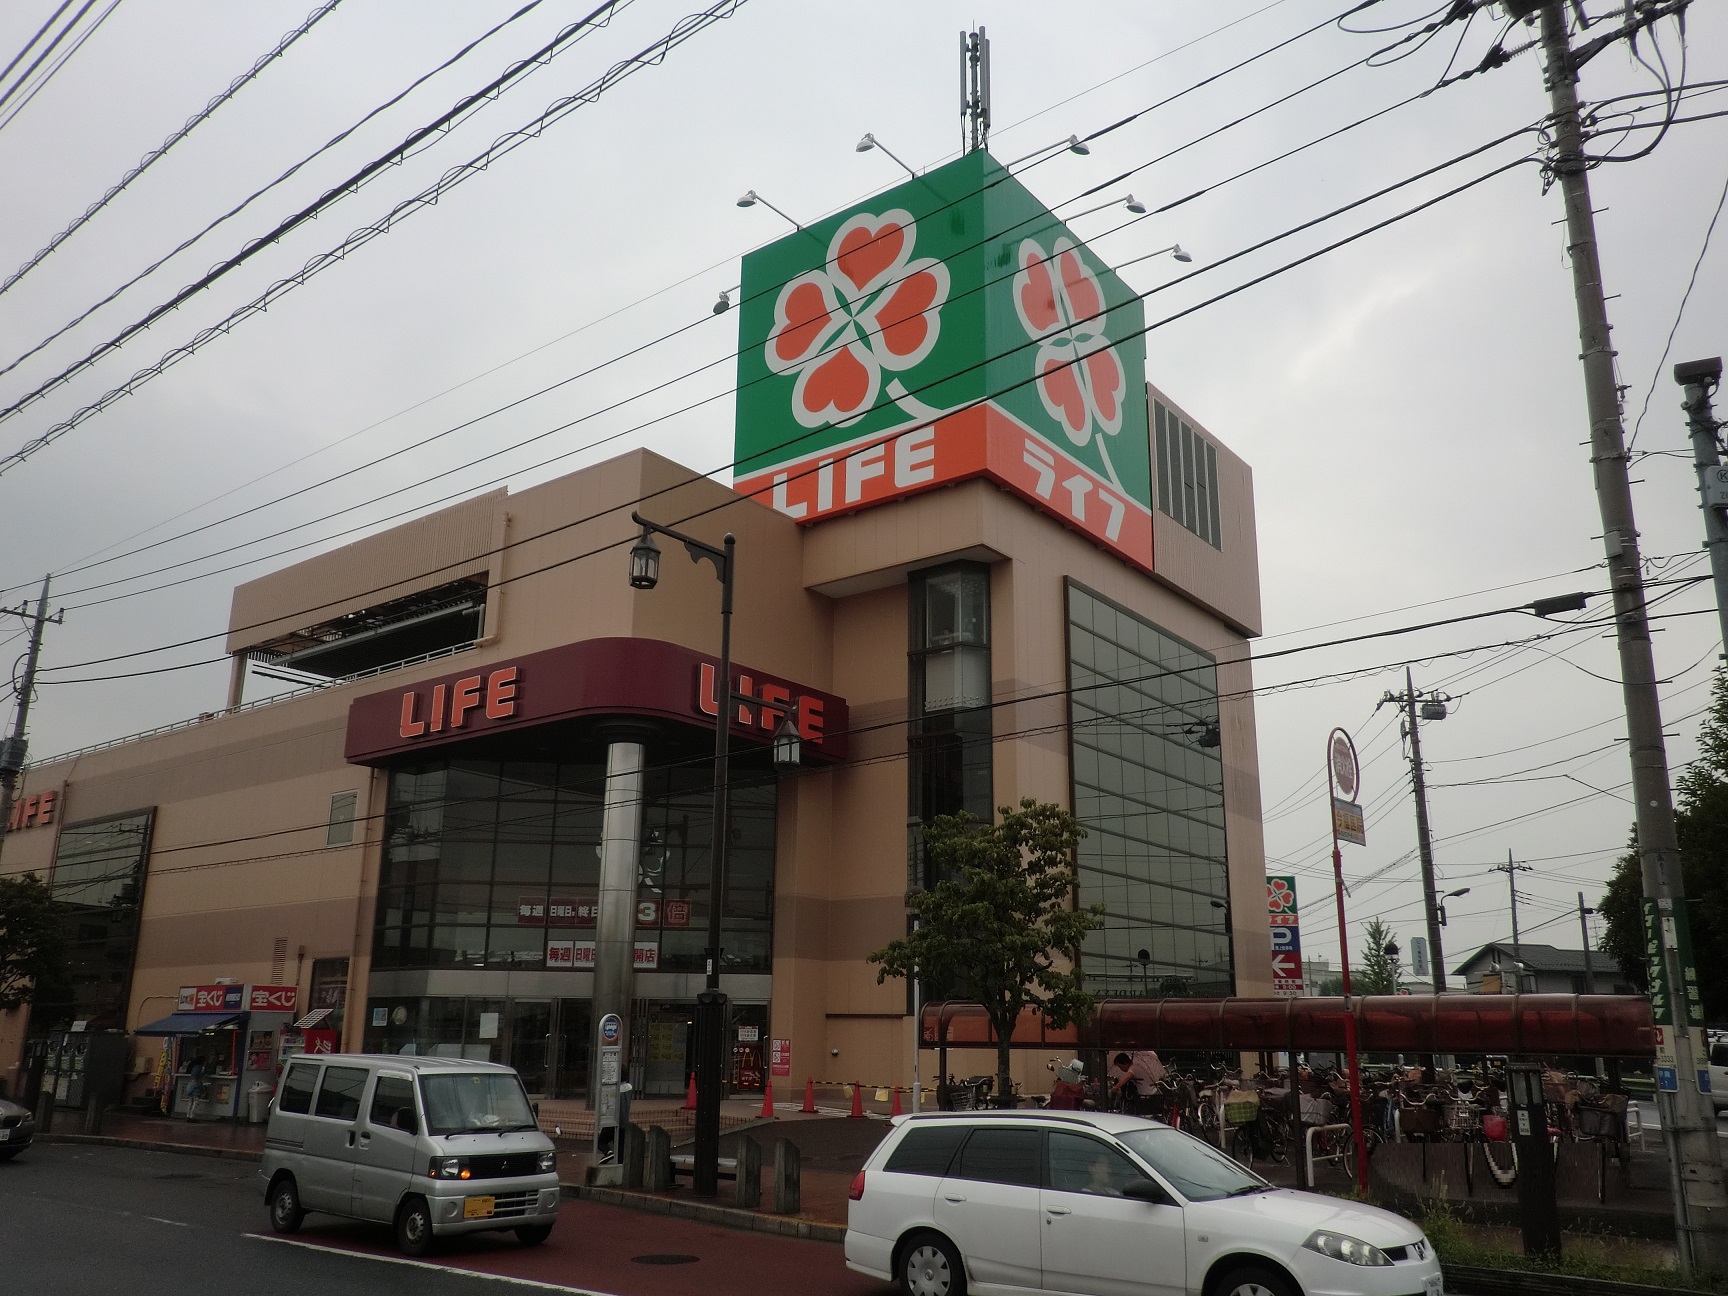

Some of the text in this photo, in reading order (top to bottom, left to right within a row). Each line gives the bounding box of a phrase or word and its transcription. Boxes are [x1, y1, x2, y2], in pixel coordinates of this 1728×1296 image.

[772, 425, 936, 518] LIFE
[1023, 437, 1126, 542] ライフ
[400, 666, 517, 738] LIFE
[701, 662, 824, 747] LIFE
[6, 791, 57, 832] IFE
[1271, 927, 1292, 950] P
[197, 991, 223, 1007] 宝くじ
[252, 991, 296, 1007] 宝くじ
